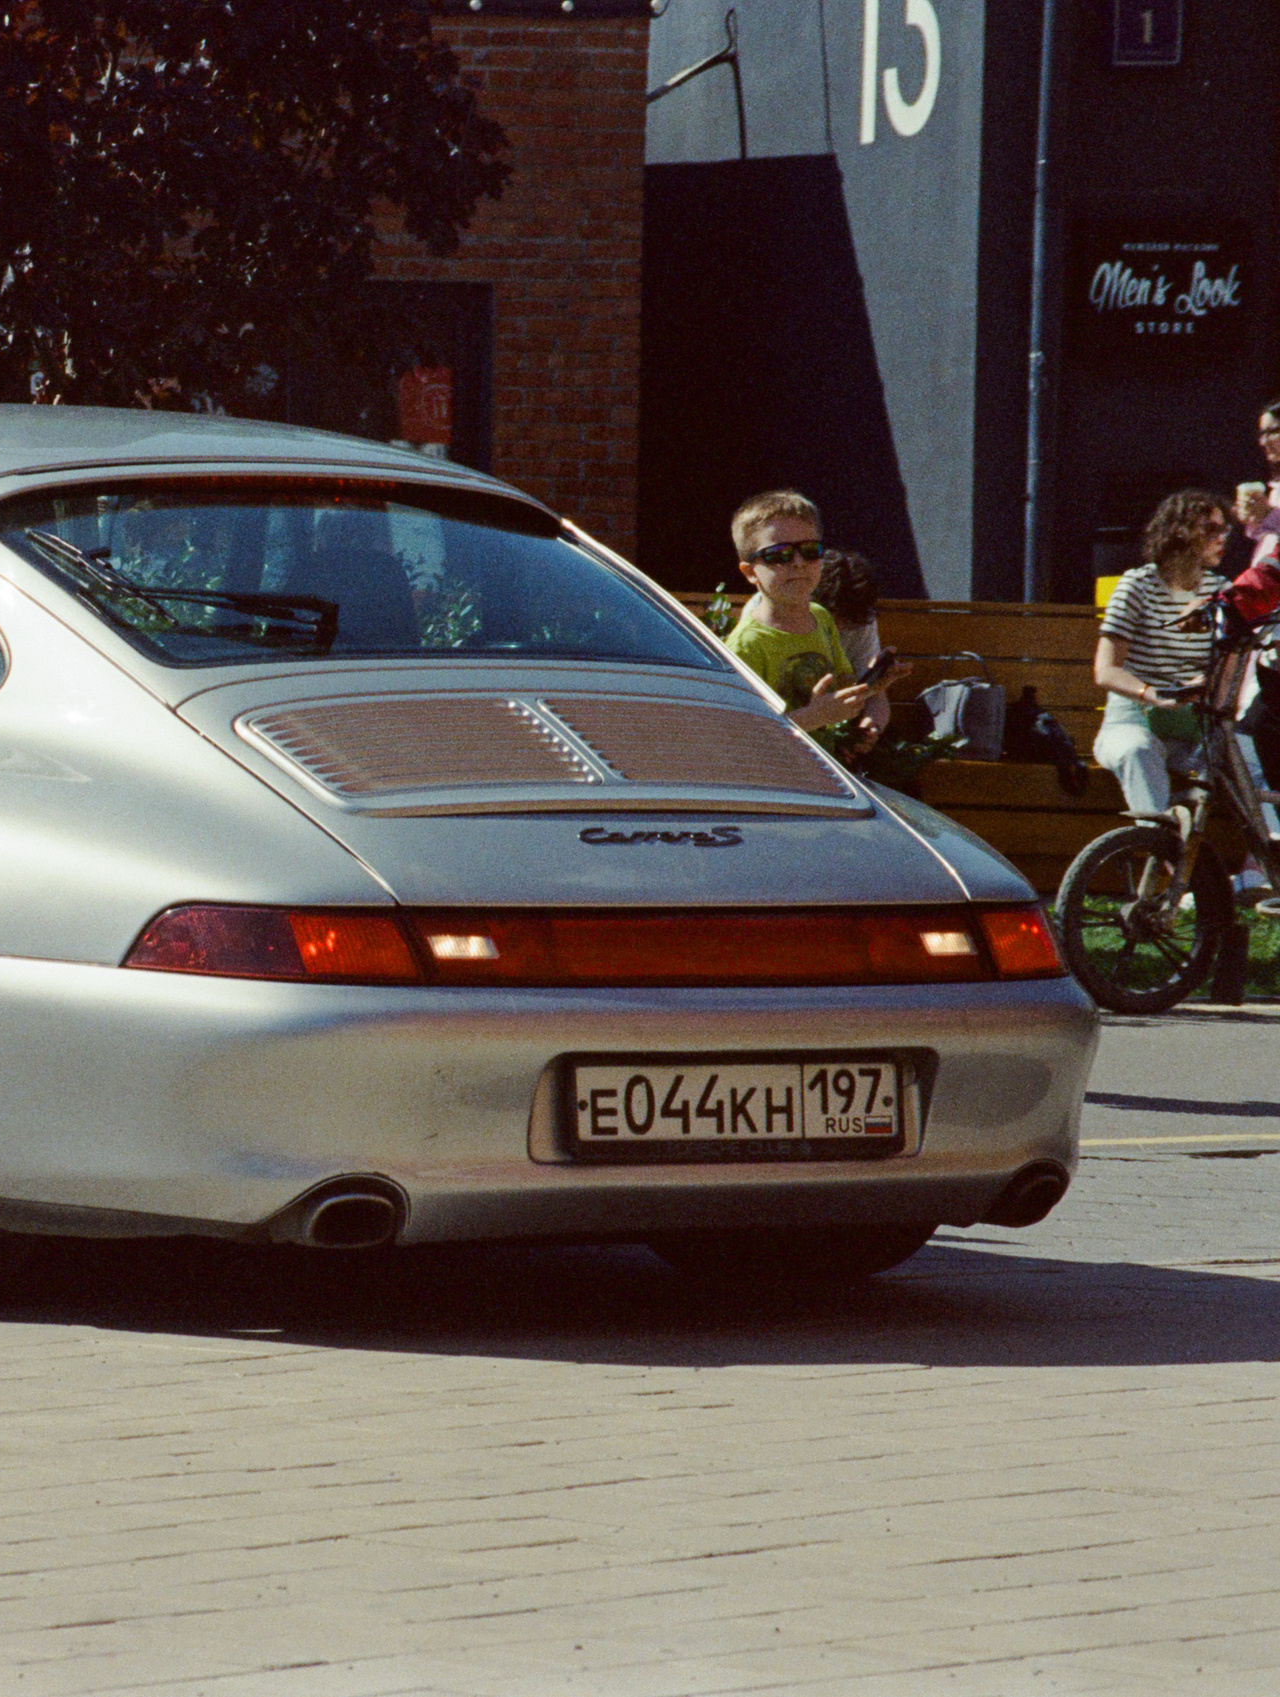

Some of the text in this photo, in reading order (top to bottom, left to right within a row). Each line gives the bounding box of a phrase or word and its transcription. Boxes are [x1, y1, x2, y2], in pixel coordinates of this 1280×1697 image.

[1140, 9, 1155, 44] 1
[1089, 260, 1241, 315] Men's Look
[1135, 321, 1194, 334] STORE
[808, 1068, 883, 1115] 197
[825, 1117, 863, 1134] RUS
